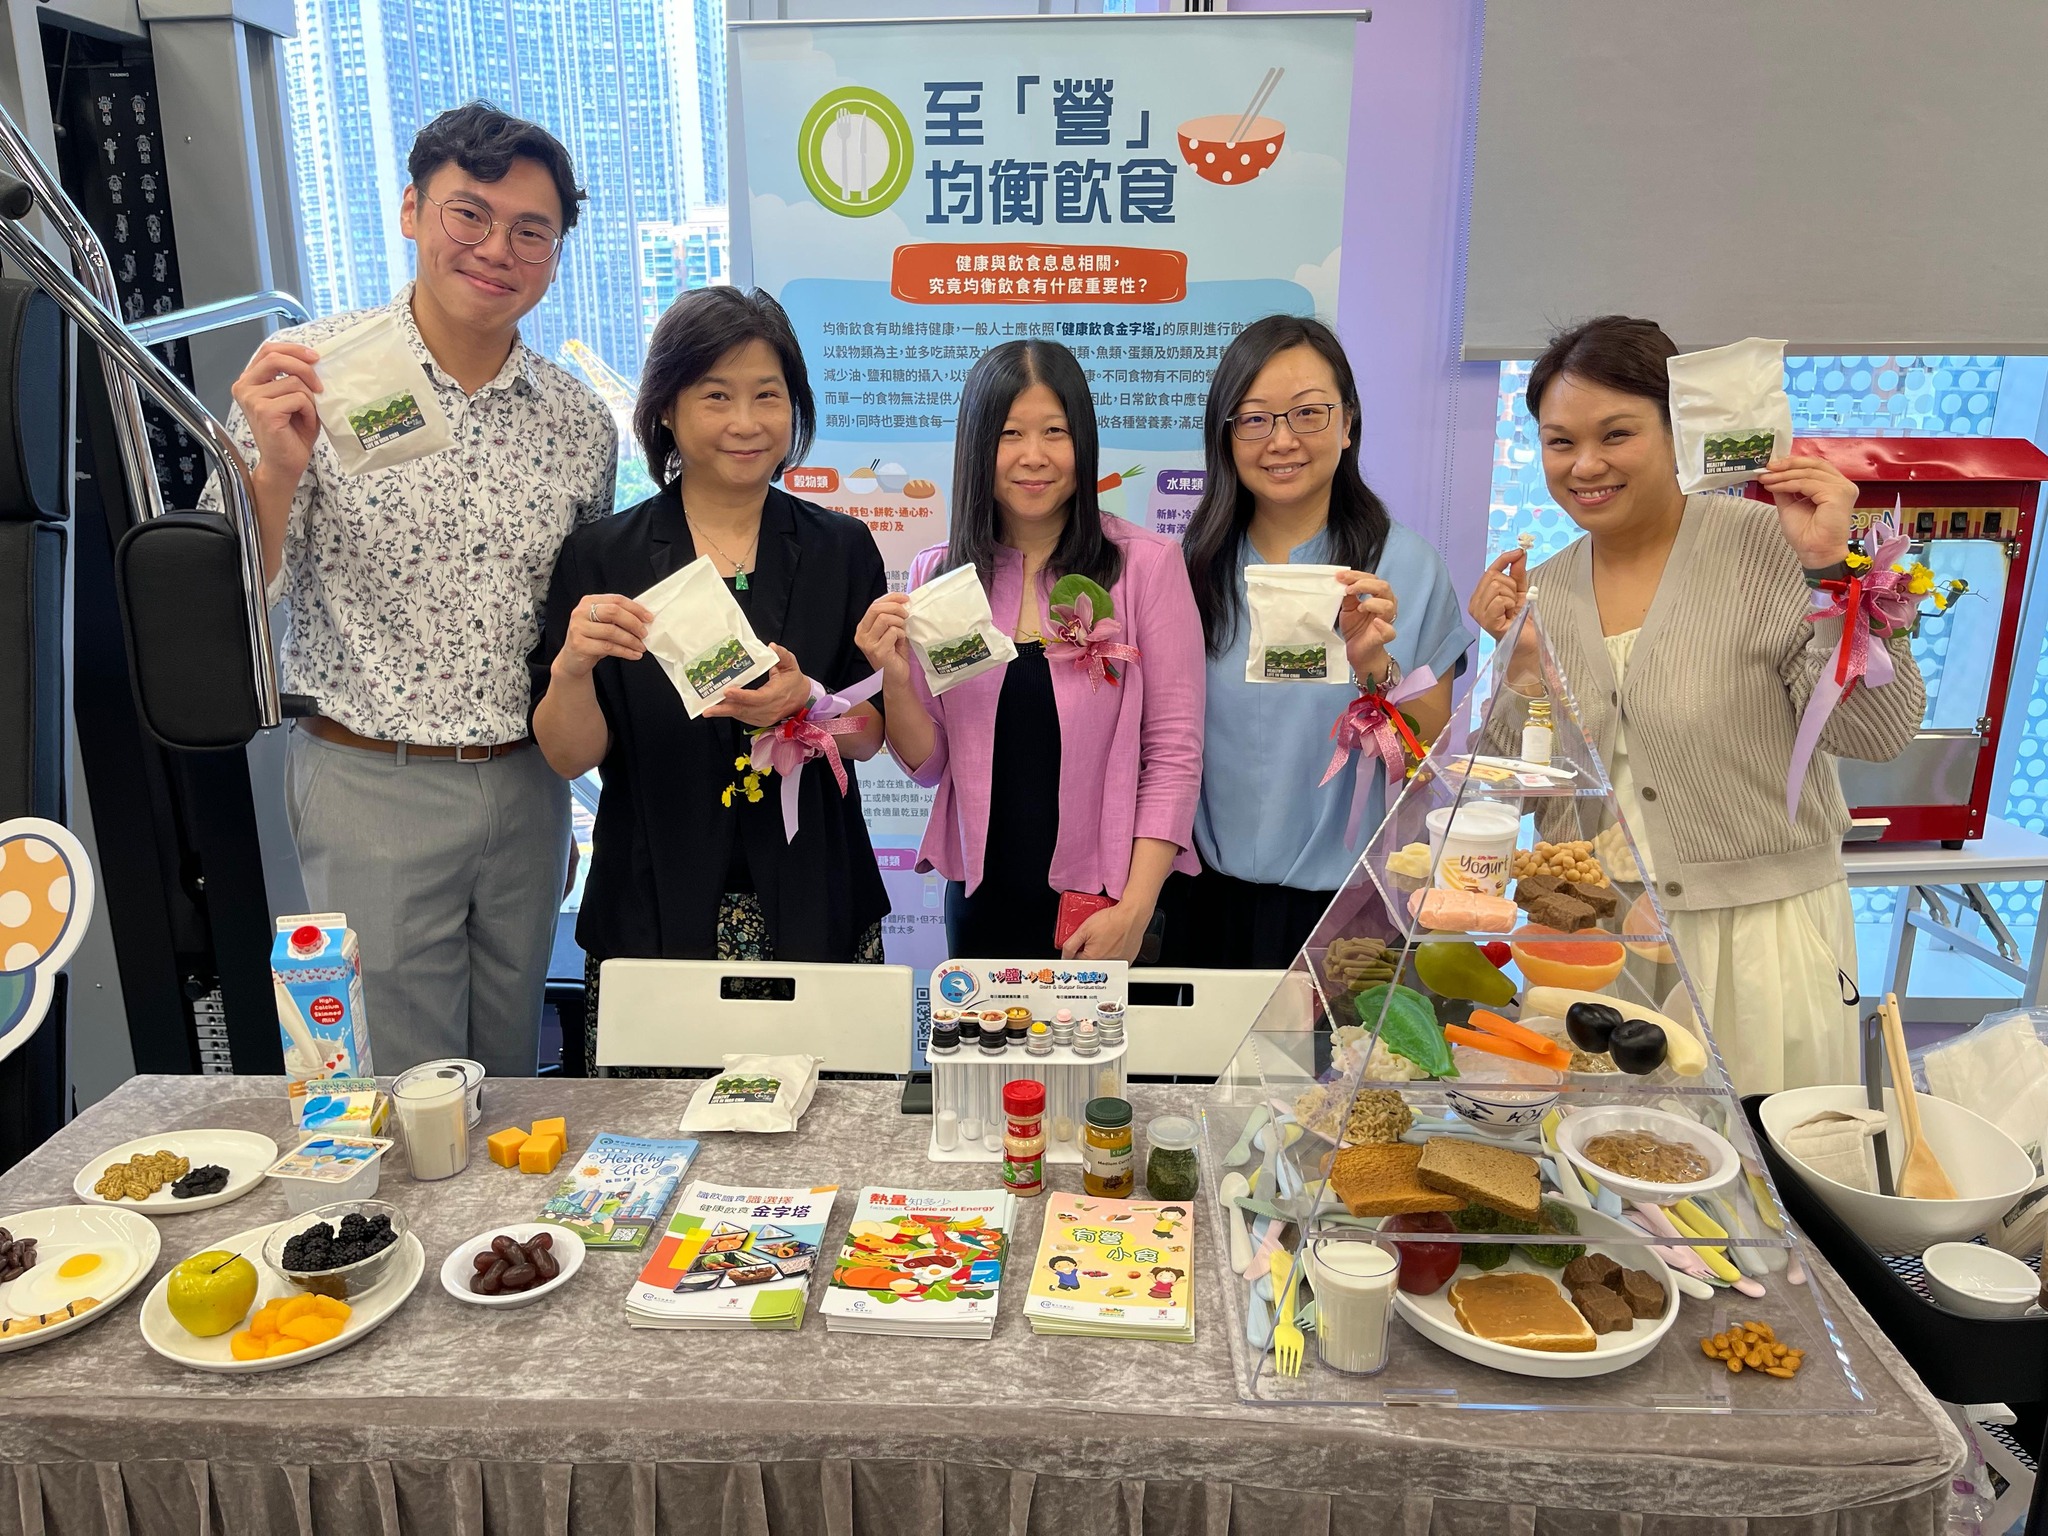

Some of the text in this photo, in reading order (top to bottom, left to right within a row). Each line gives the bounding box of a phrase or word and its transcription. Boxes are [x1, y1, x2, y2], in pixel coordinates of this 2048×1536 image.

[924, 74, 1150, 149] 至「營」
[925, 158, 1178, 226] 均衡飲食
[955, 254, 1122, 273] 健康與飲食息息相關，
[823, 321, 1252, 337] 均衡飲食有助維持健康，一般人士應依照「健康飲食金字塔」的原則進行飲
[825, 414, 958, 428] 類別，同時也要進食每一
[793, 475, 829, 489] 穀物類
[1166, 477, 1204, 491] 水果類
[1460, 854, 1509, 879] Yogurt
[599, 1152, 671, 1169] Healthy
[611, 1164, 650, 1176] Life
[1072, 1227, 1124, 1245] 有營
[1106, 1246, 1160, 1264] 小食
